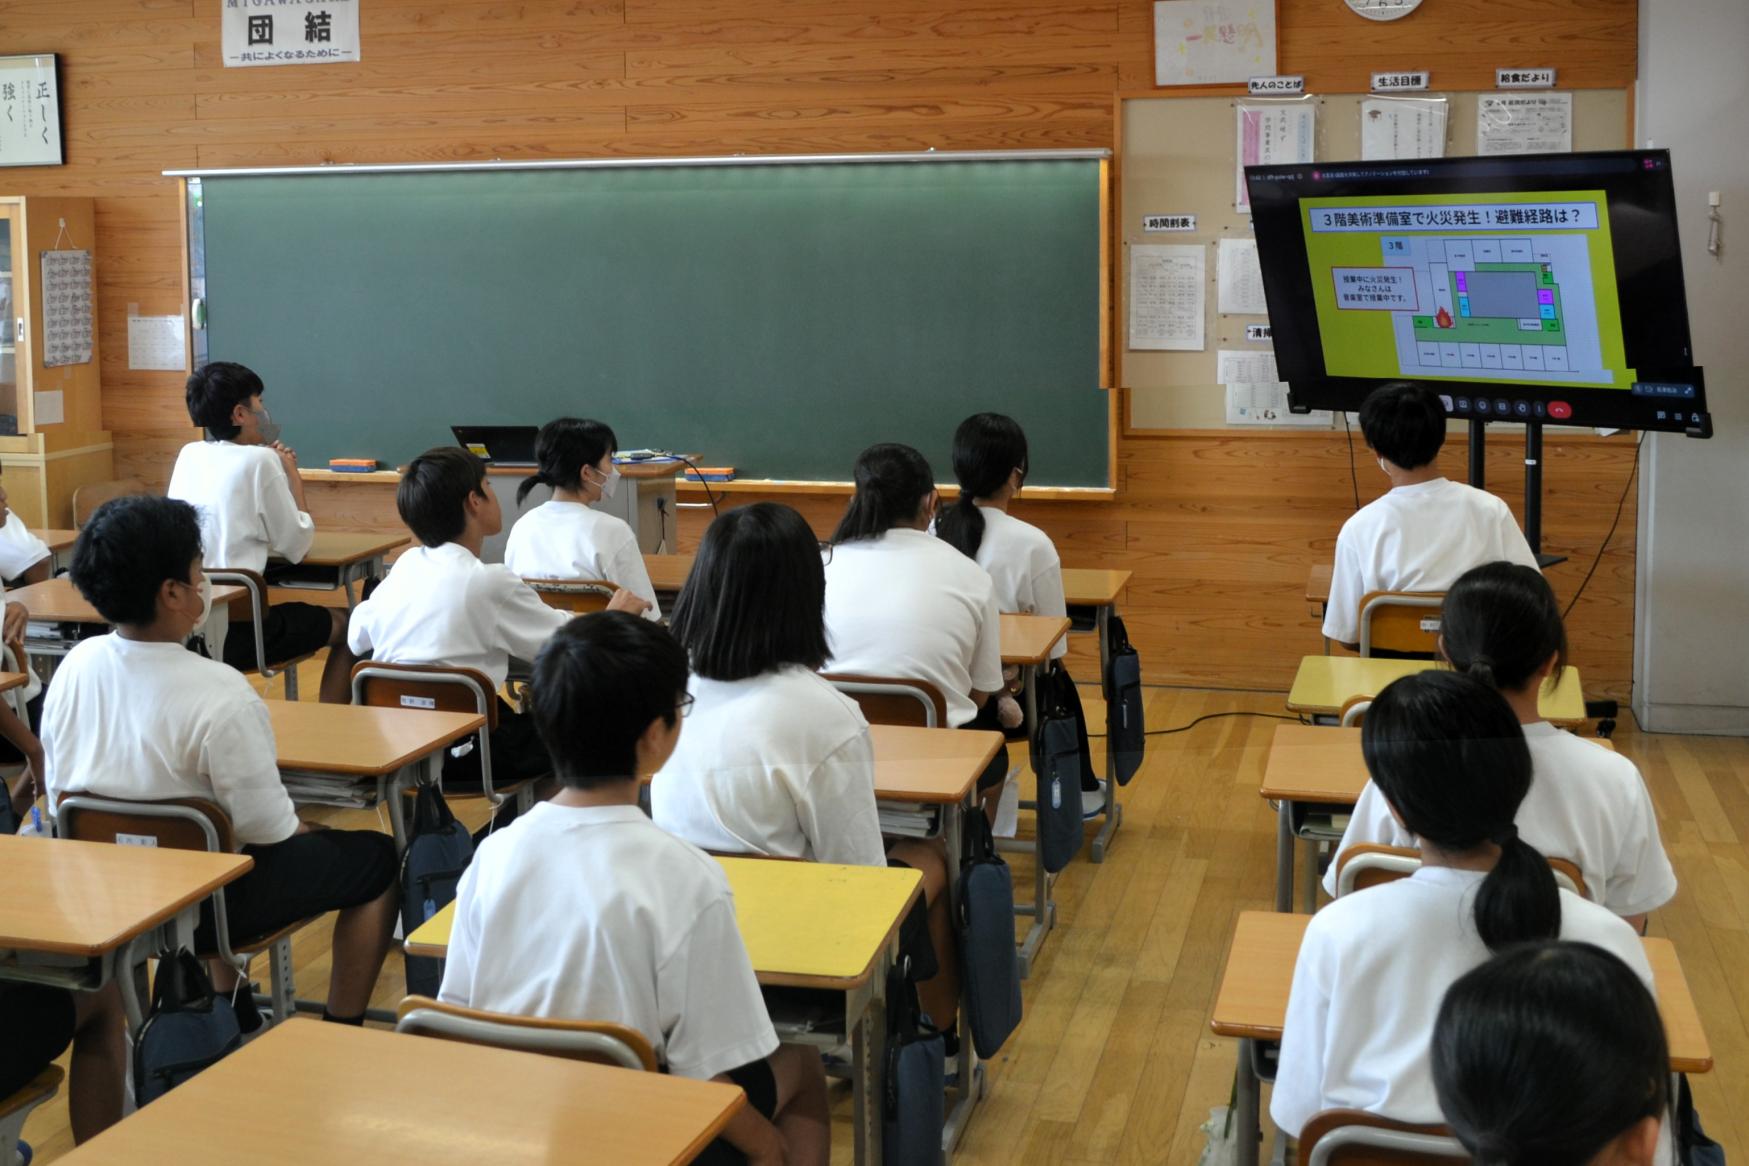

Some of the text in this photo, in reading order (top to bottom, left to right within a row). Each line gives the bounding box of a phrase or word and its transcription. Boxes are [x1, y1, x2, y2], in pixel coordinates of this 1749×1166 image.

[1378, 75, 1422, 87] 生活目標
[1501, 73, 1550, 83] 給食だより
[1251, 80, 1302, 89] 先人のことば
[36, 81, 50, 144] 正しく
[1149, 218, 1190, 228] 時間割表
[1358, 285, 1392, 293] みなさんは
